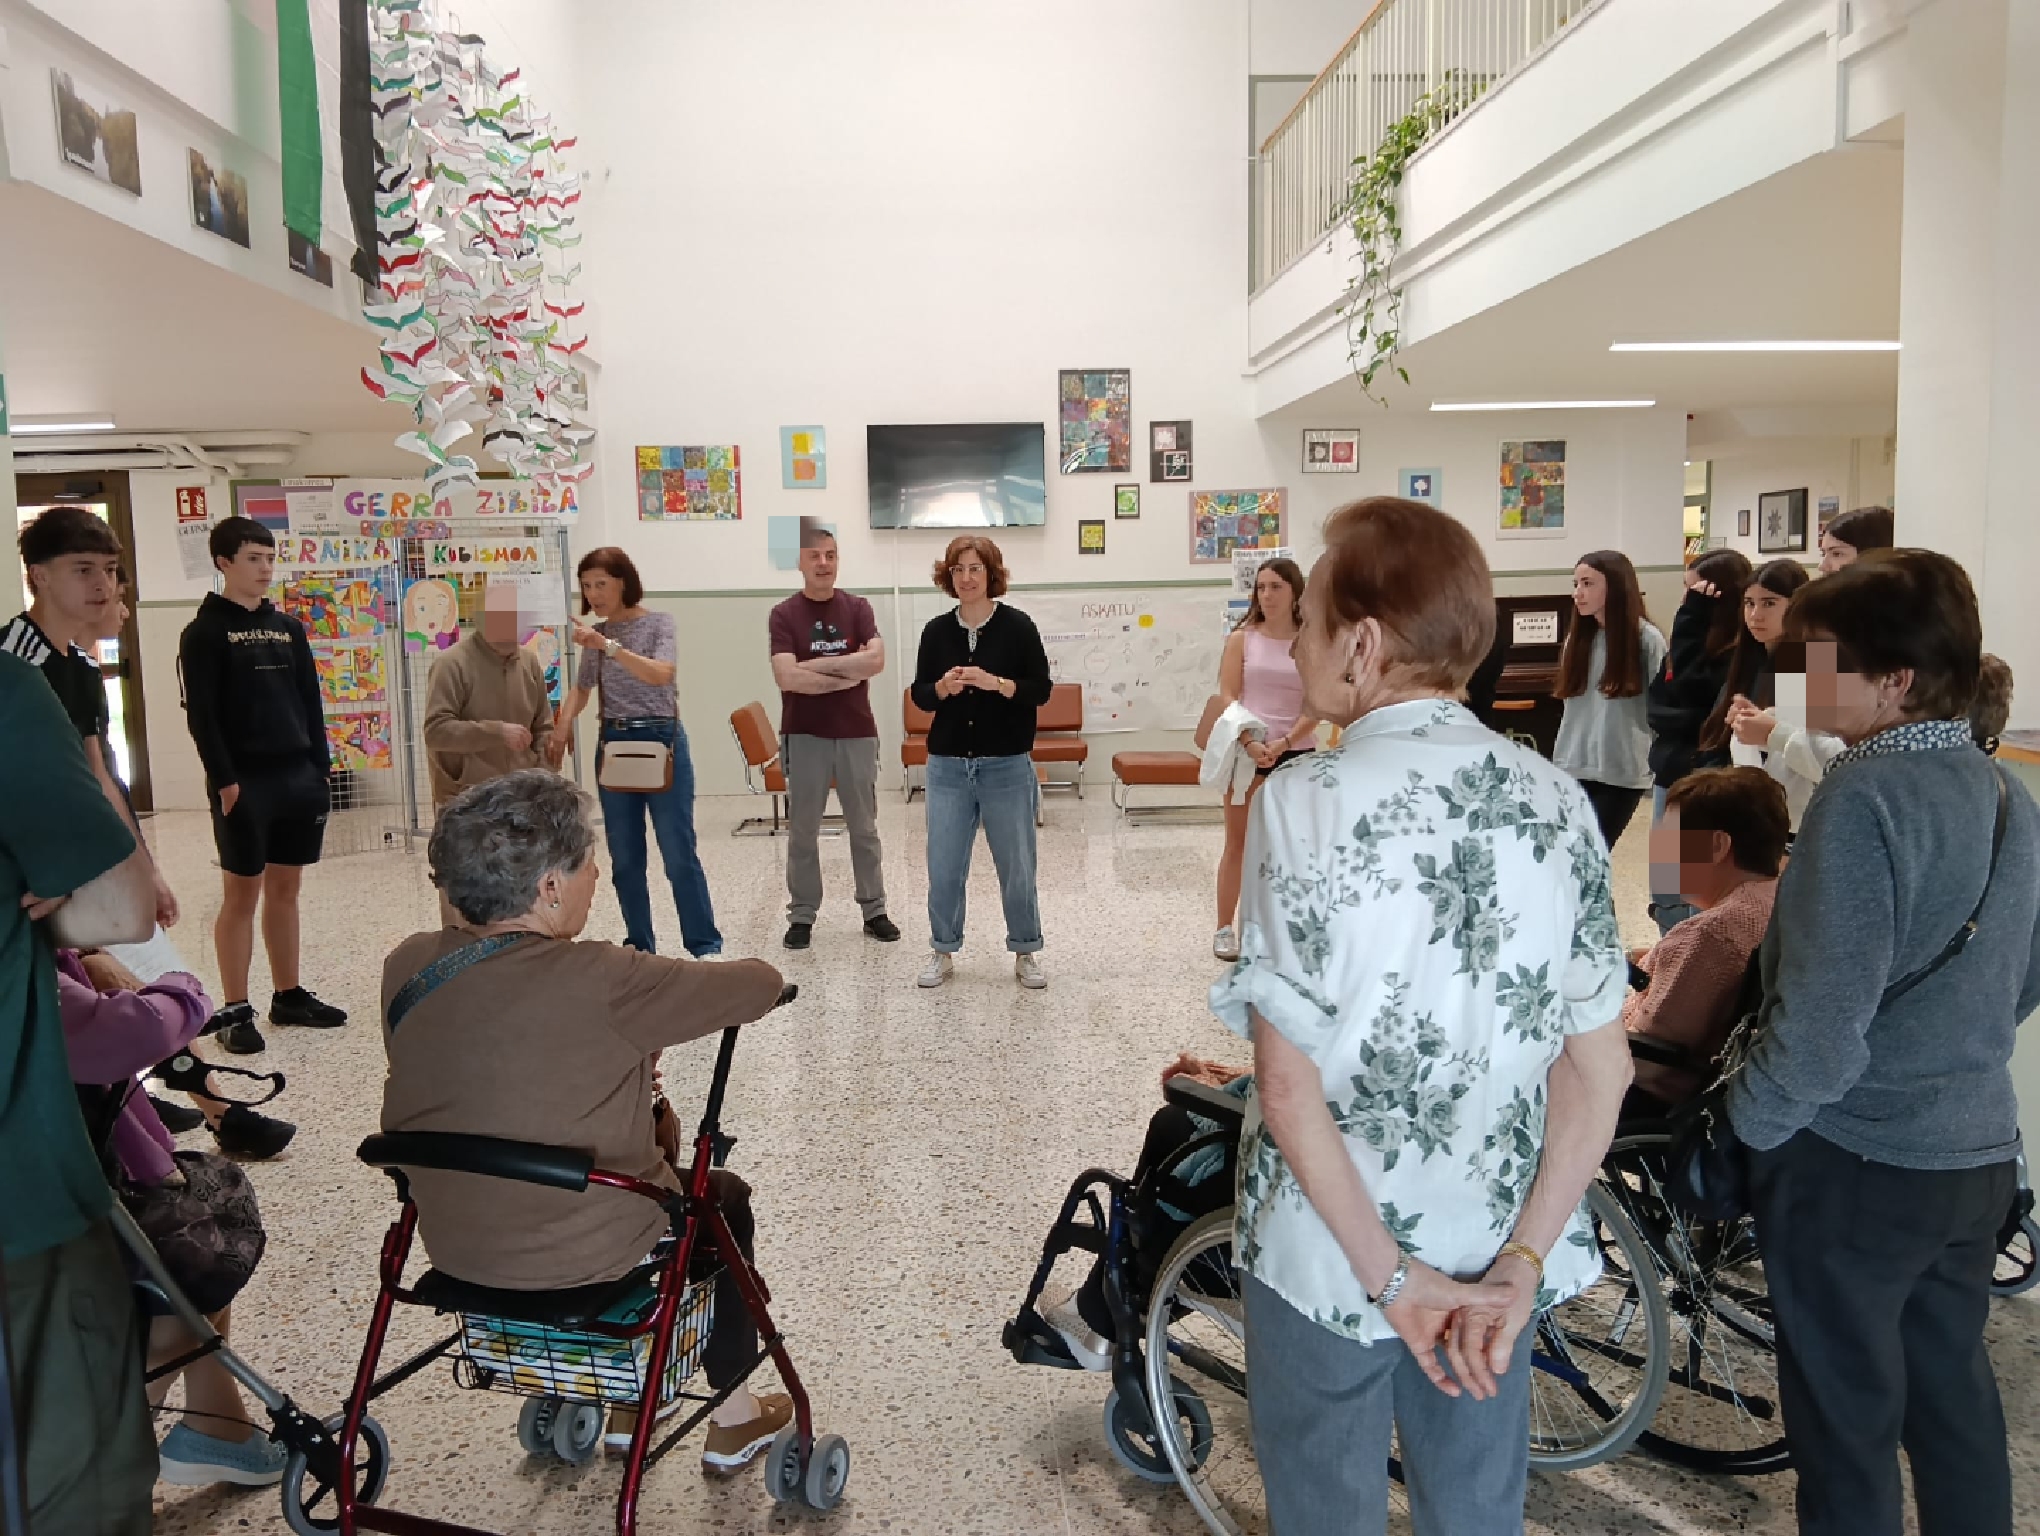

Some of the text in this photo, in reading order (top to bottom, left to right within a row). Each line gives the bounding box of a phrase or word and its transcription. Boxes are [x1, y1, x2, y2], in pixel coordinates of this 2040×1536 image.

[344, 491, 453, 517] GERRA
[277, 537, 392, 564] ERNiKA
[1080, 603, 1136, 618] ASKATU
